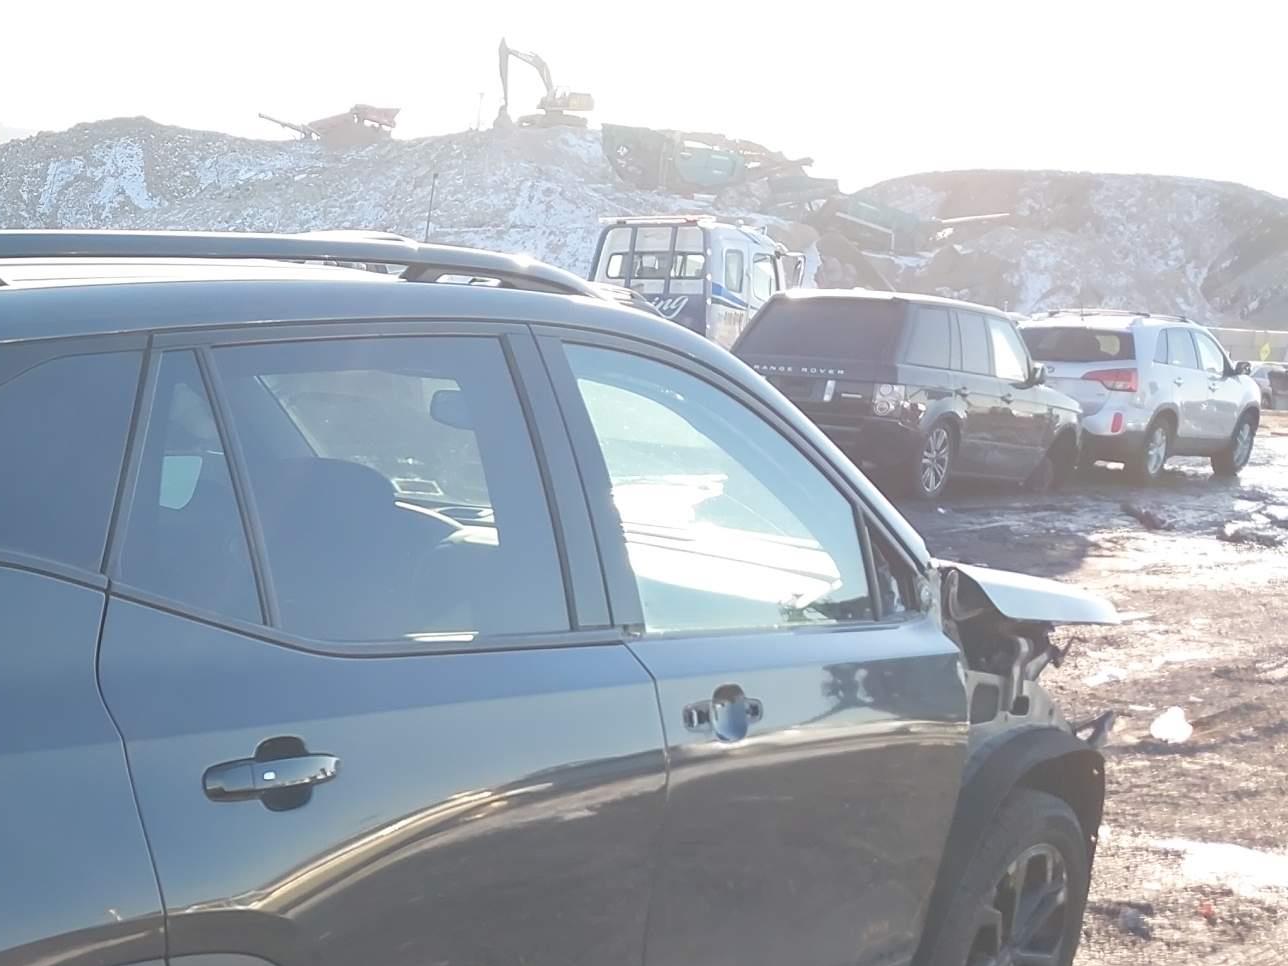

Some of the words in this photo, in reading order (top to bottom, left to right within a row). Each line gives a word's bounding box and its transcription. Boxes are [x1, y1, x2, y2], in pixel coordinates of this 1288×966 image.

[652, 295, 689, 319] ing
[753, 364, 793, 372] RANGE
[801, 367, 845, 375] ROVER
